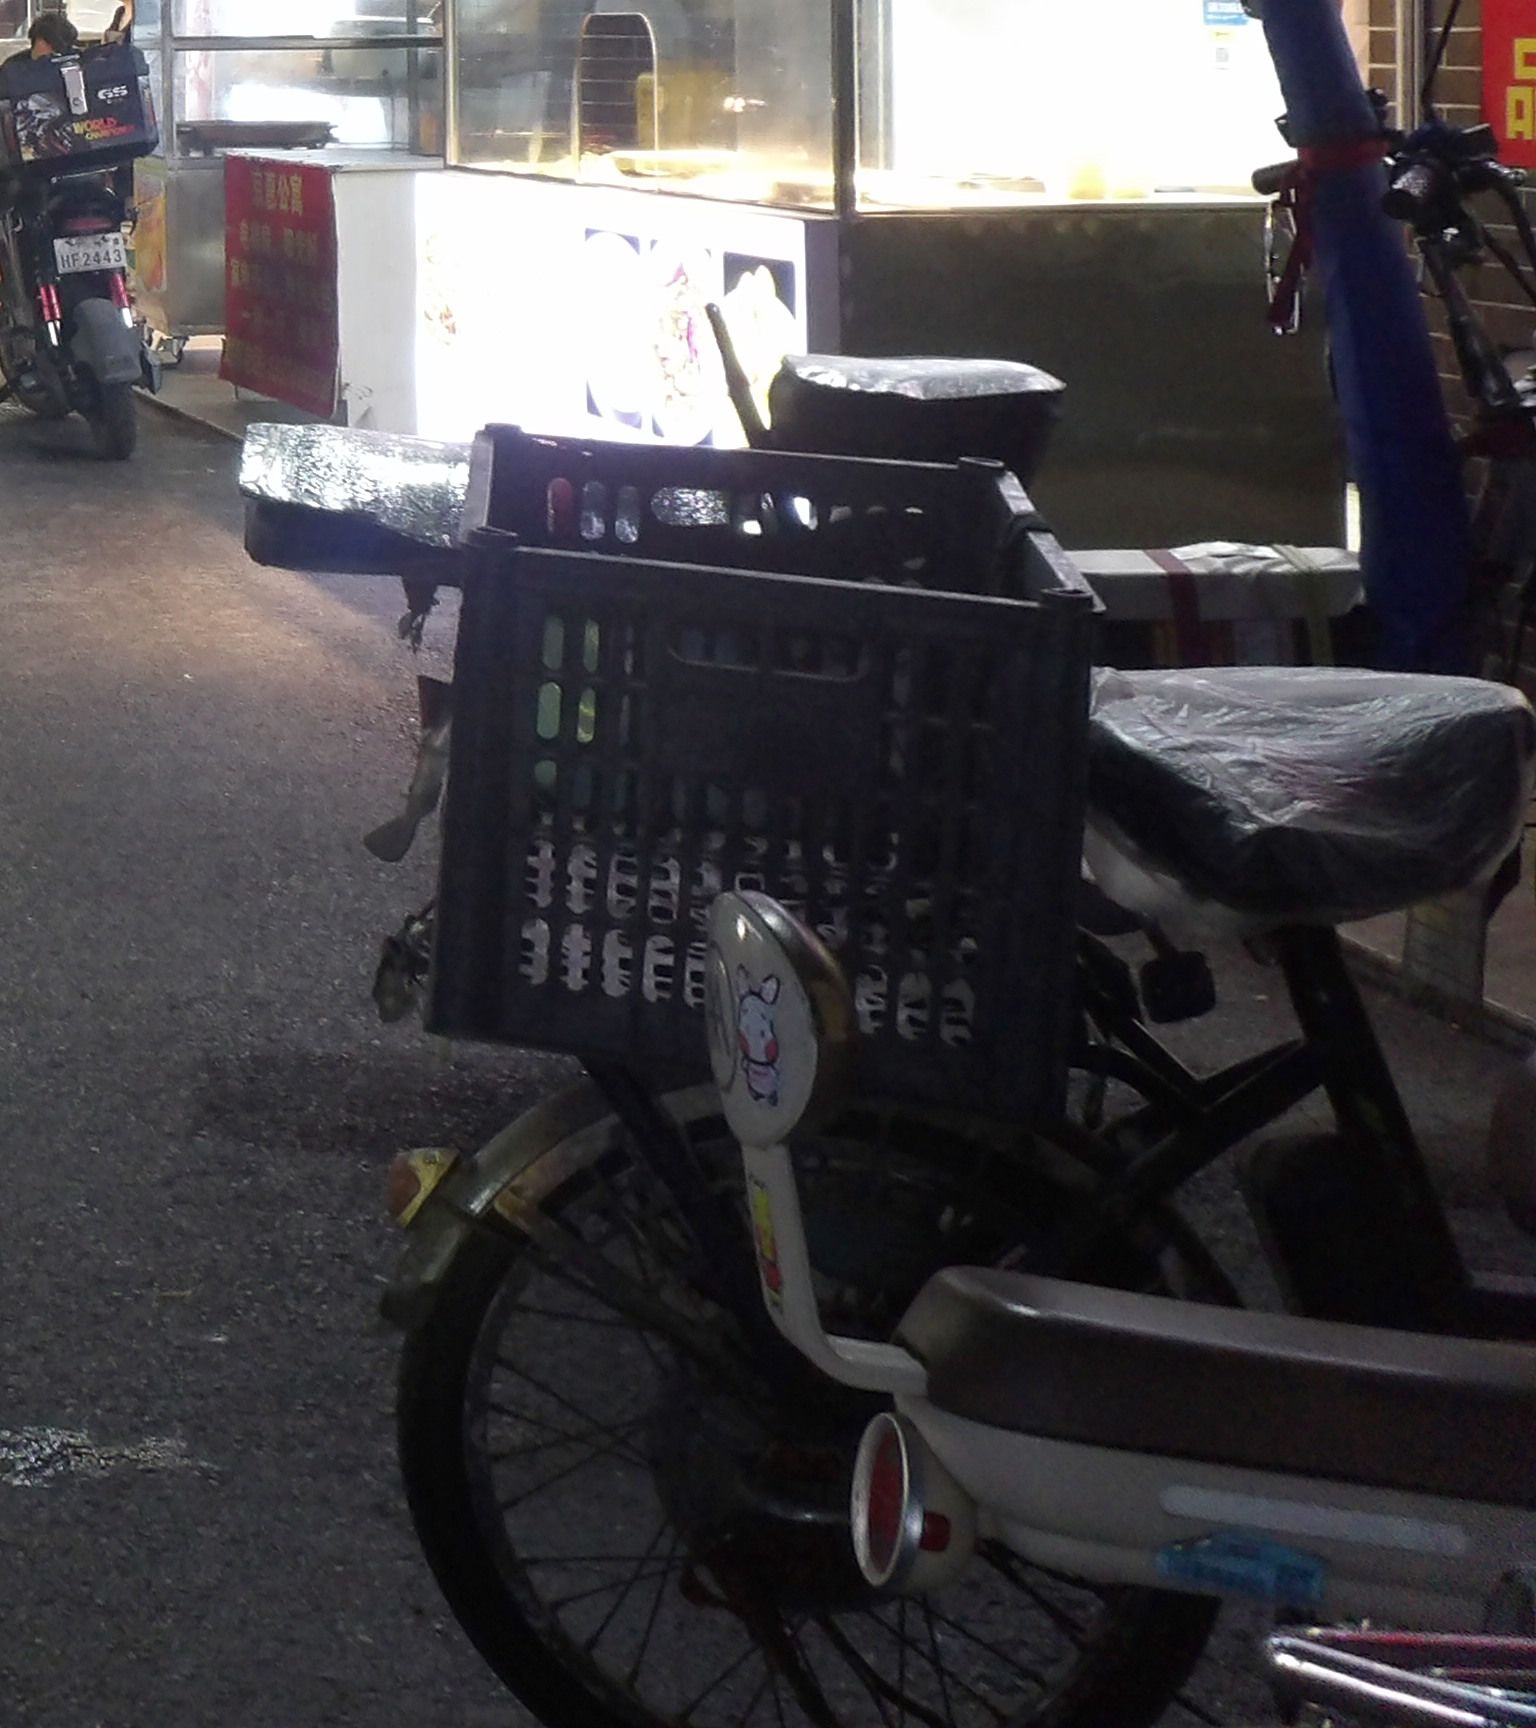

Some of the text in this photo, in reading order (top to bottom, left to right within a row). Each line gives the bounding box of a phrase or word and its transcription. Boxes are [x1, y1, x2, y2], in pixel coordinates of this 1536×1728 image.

[97, 85, 128, 100] GS
[72, 117, 118, 135] WORLD
[60, 248, 122, 269] HF2443
